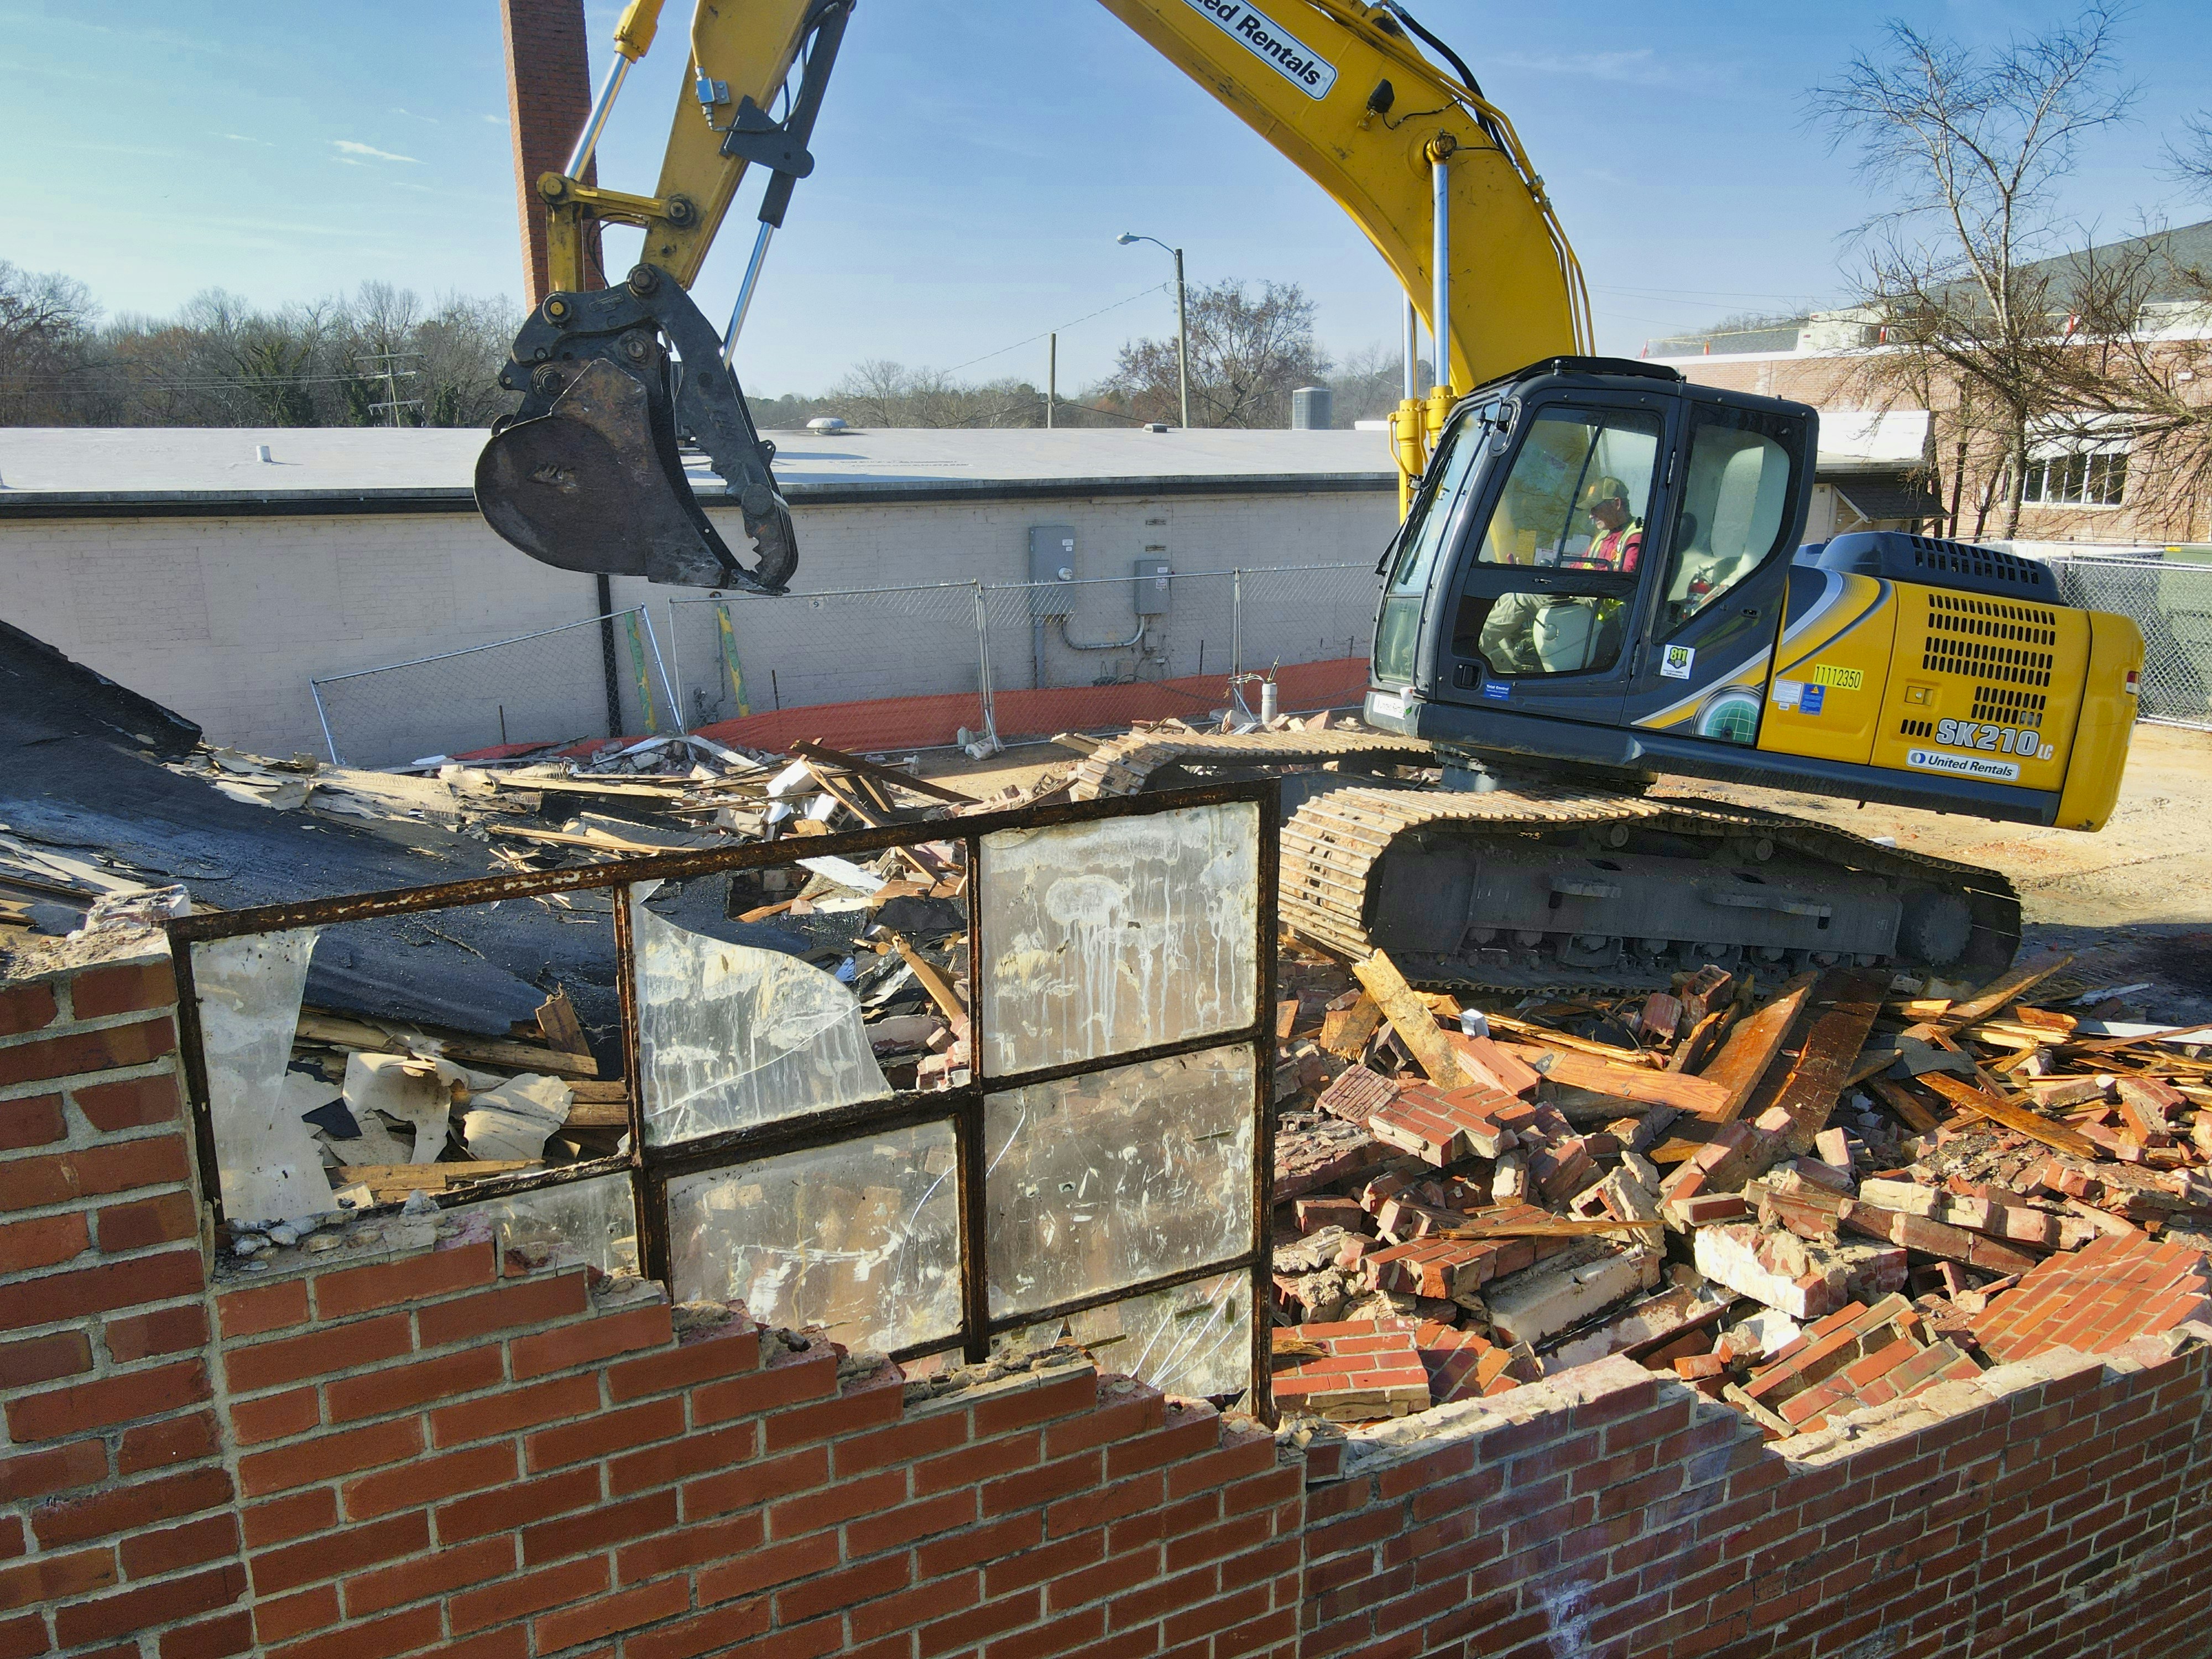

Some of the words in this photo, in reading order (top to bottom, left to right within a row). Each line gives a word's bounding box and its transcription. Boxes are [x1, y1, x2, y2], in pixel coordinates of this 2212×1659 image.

[1196, 0, 1241, 22] ed
[1235, 13, 1321, 86] Rentals
[1670, 647, 1688, 661] 811
[1814, 666, 1861, 688] 11112350
[1936, 718, 2040, 757] SK210
[2037, 743, 2054, 760] LC
[1928, 754, 1968, 770] United
[1969, 761, 2013, 777] Rentals
